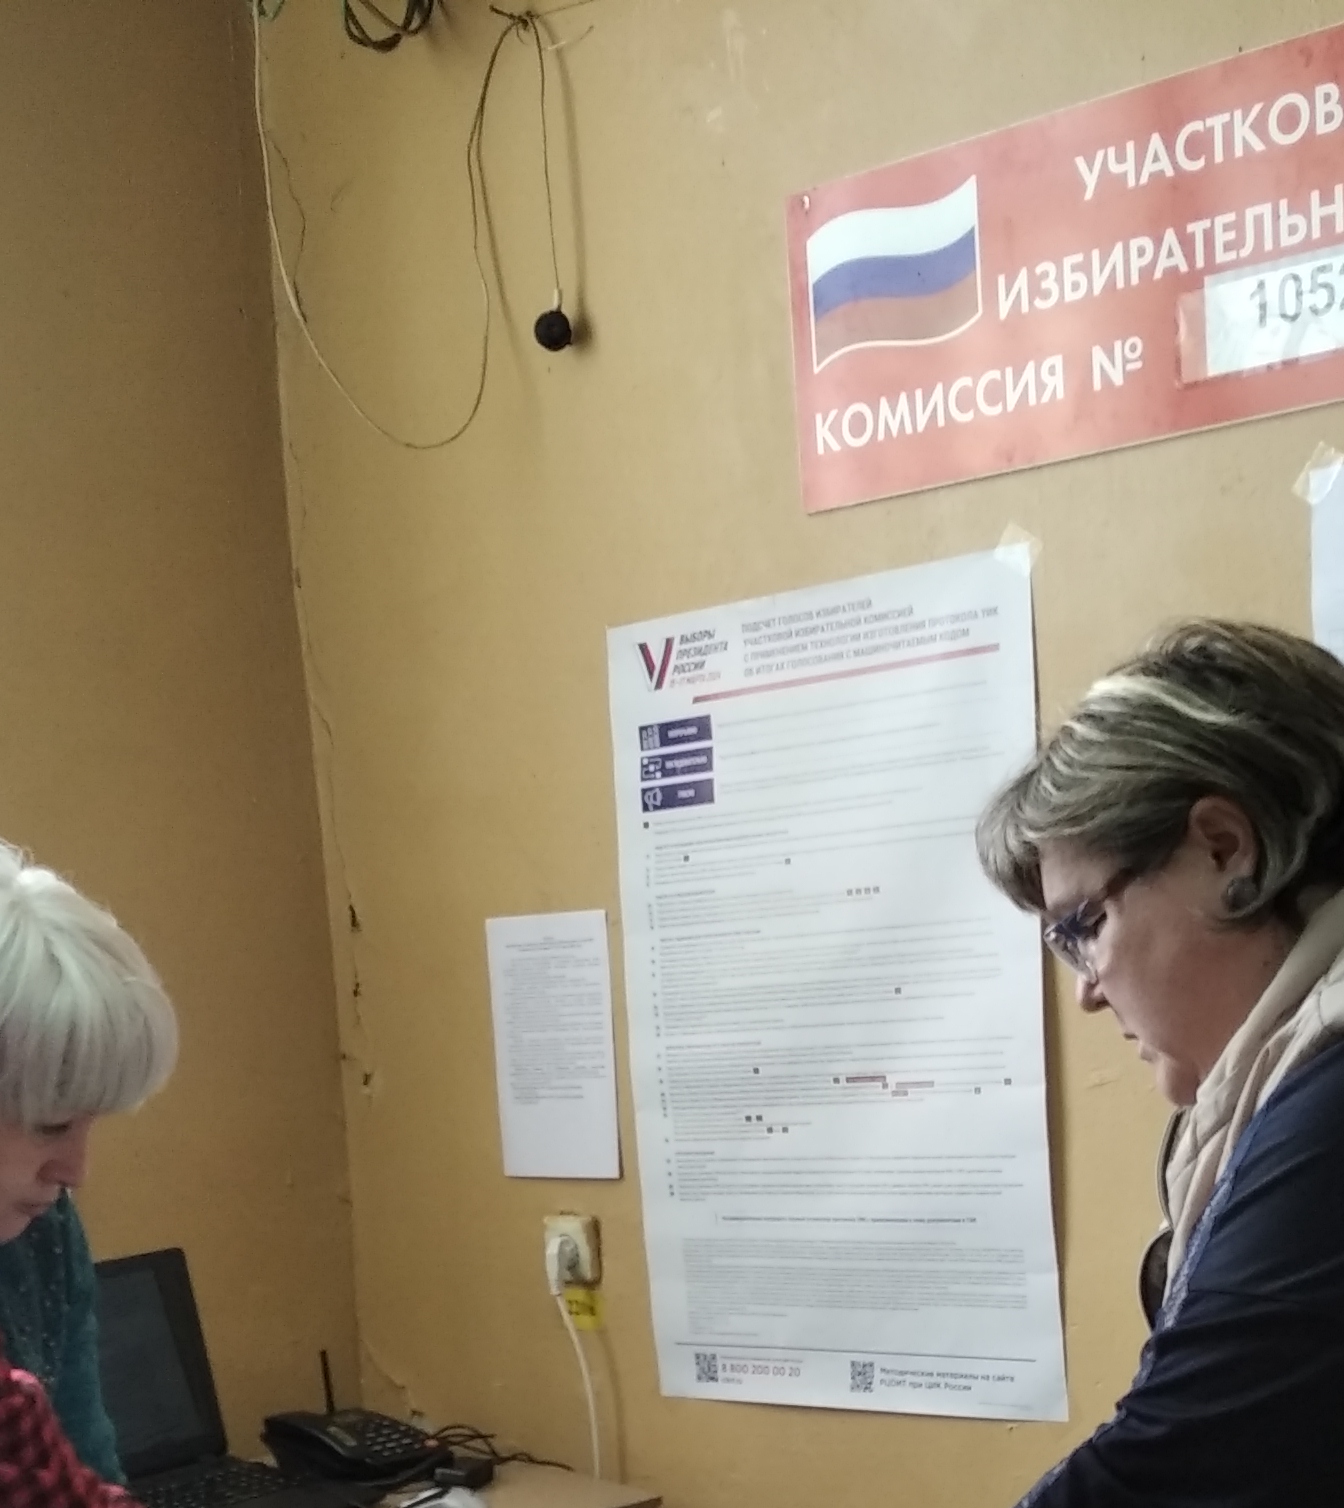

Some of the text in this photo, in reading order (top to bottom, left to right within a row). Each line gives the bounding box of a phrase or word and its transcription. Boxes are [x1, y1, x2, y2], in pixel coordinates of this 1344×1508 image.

[814, 355, 1065, 455] КОМИССИЯ
[1091, 336, 1144, 390] №
[679, 629, 716, 645] ВЫБОРЫ
[676, 641, 729, 660] ПРЕЗИДЕНТА
[730, 1363, 749, 1374] 800
[752, 1364, 770, 1375] 200
[772, 1366, 785, 1377] 00
[788, 1366, 801, 1377] 20
